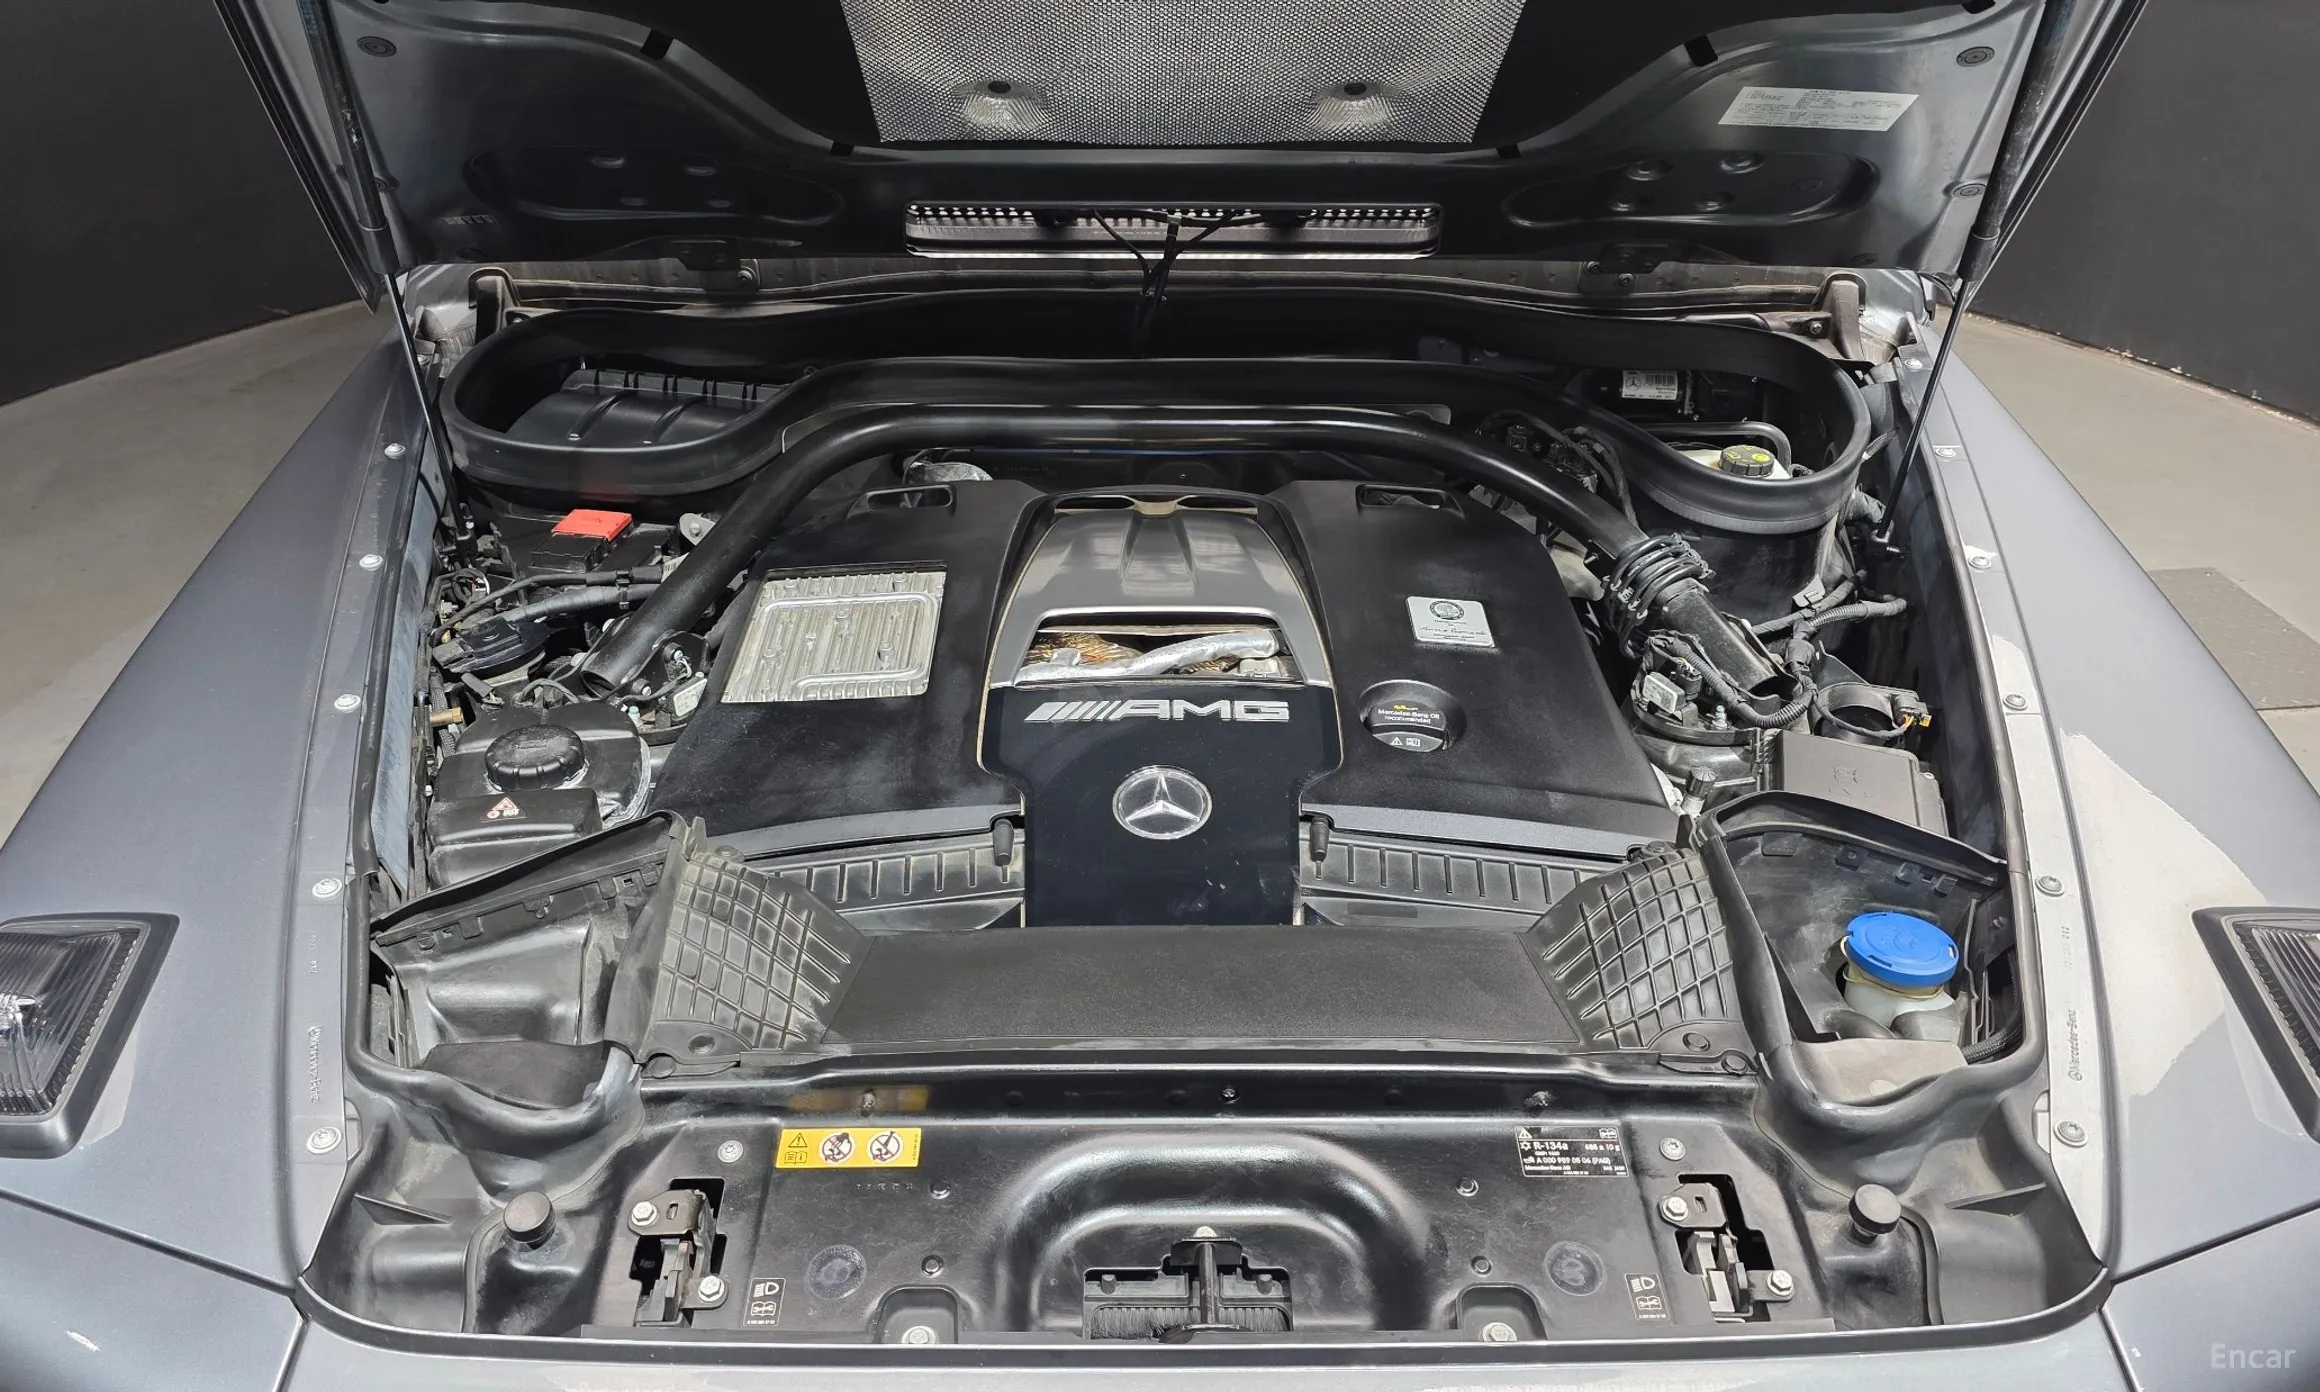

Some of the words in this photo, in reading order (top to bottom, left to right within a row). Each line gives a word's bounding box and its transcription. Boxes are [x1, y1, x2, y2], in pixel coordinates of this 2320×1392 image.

[1108, 699, 1290, 722] AMG
[1378, 709, 1429, 719] Mercedes-Benz
[1385, 715, 1431, 724] recommended
[1533, 1141, 1569, 1151] R-134a
